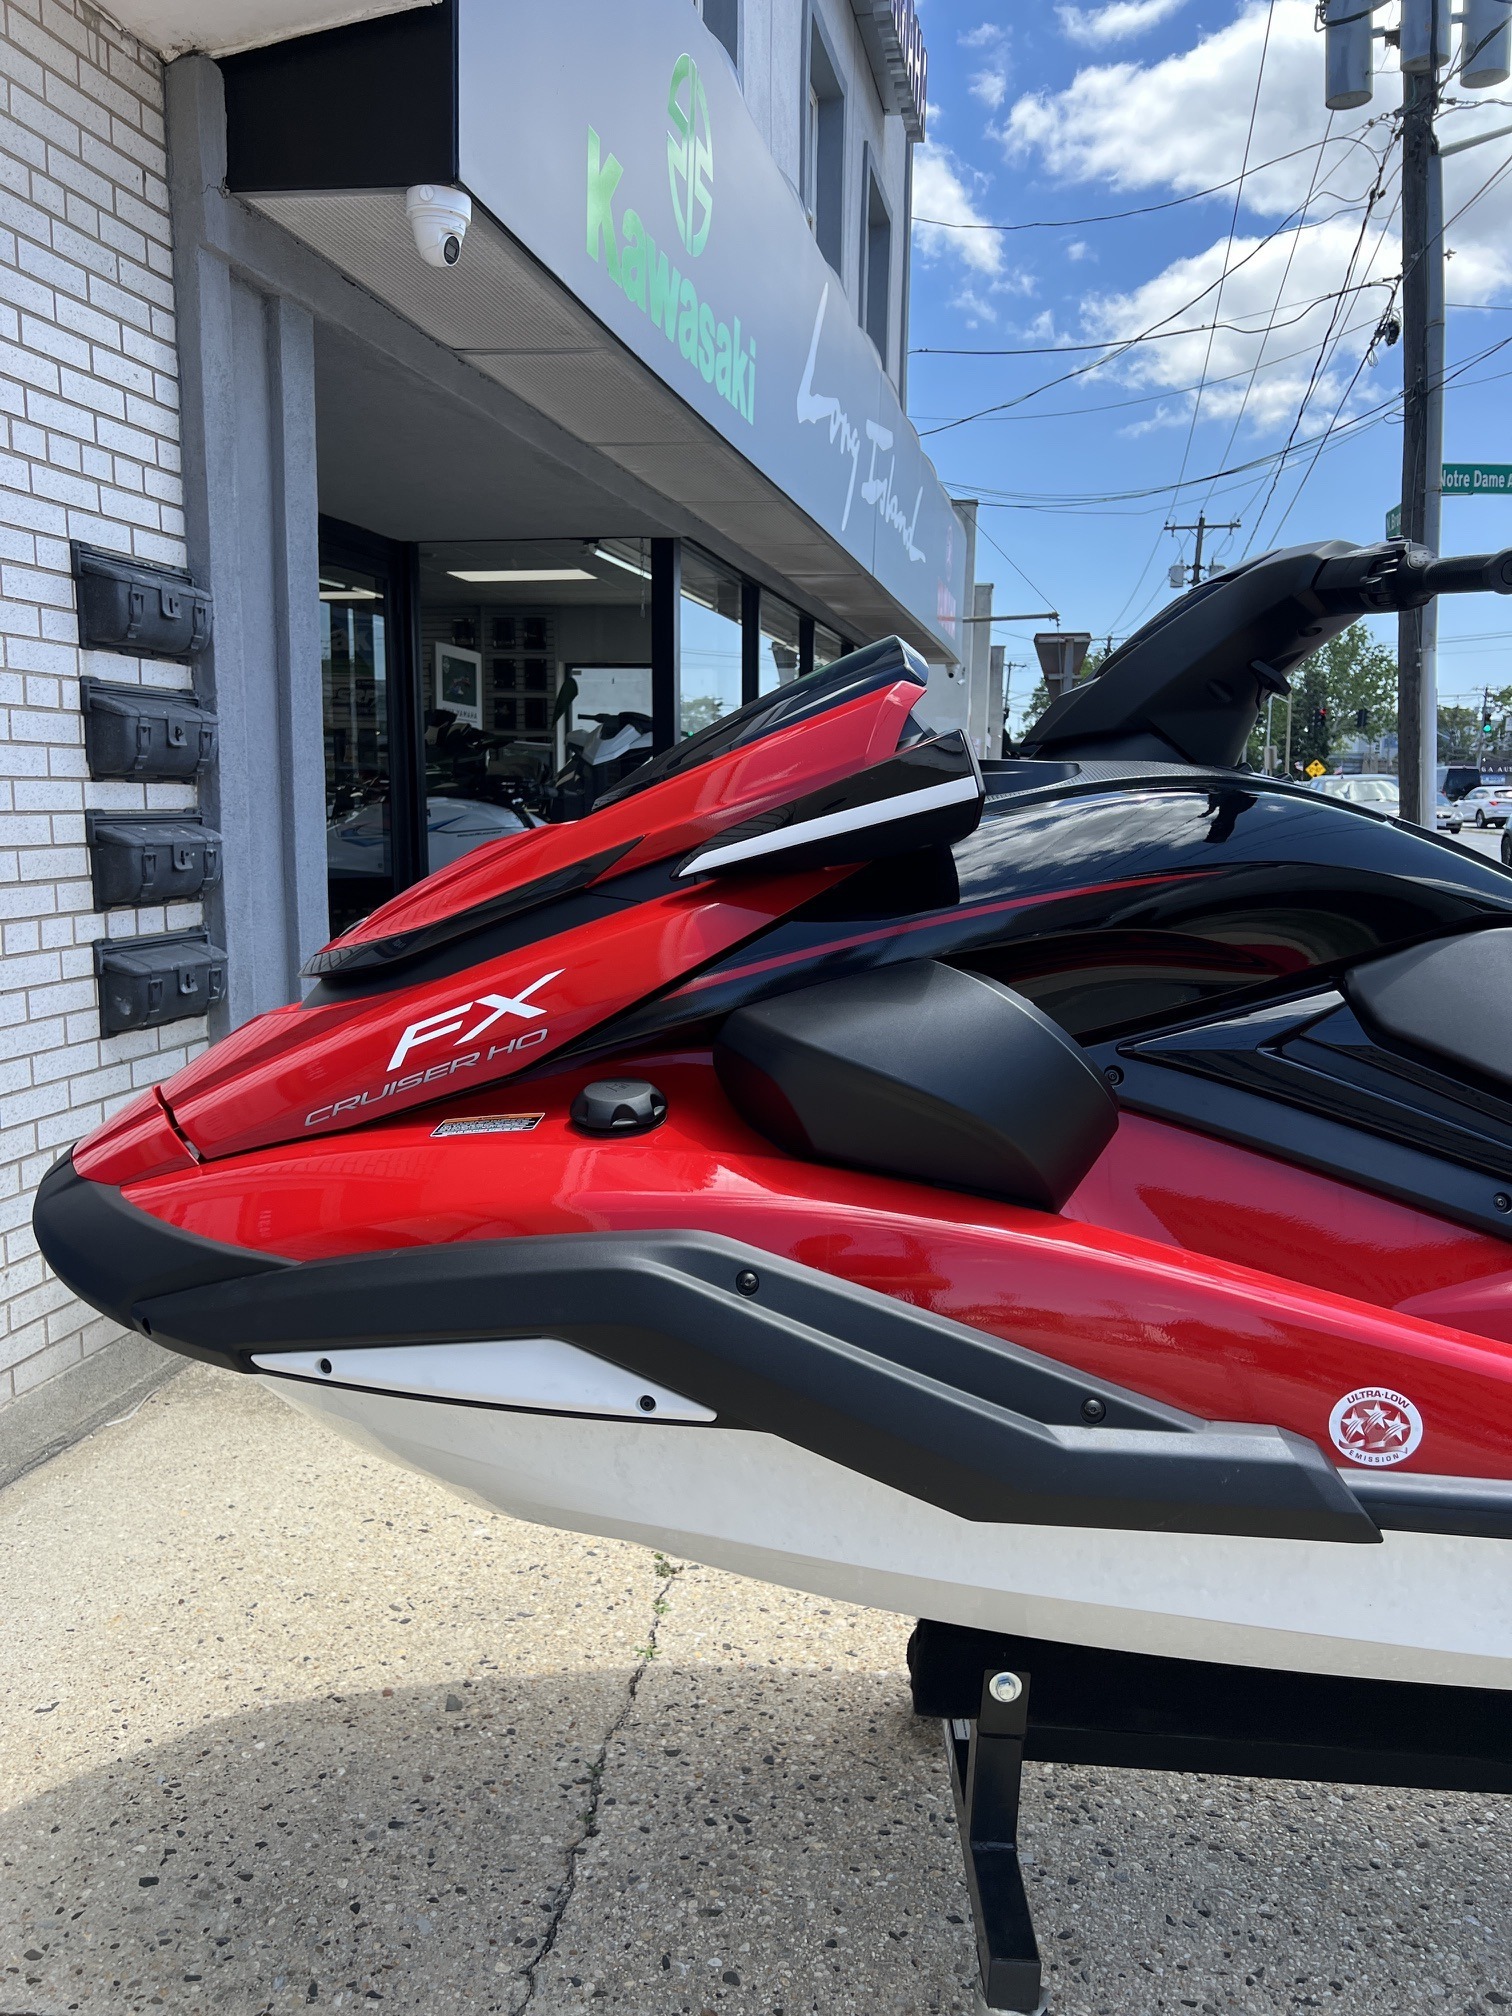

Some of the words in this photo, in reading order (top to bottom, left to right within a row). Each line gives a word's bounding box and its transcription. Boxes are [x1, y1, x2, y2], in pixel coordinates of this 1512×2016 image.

[586, 123, 756, 426] Kawasaki
[797, 281, 860, 533] Long
[861, 418, 927, 563] Island
[1440, 469, 1470, 487] Notre
[1473, 469, 1505, 487] Dame
[386, 968, 567, 1072] FX
[304, 1051, 481, 1127] CRUISER
[486, 1028, 548, 1061] HO
[1348, 1449, 1400, 1463] EMISSION
